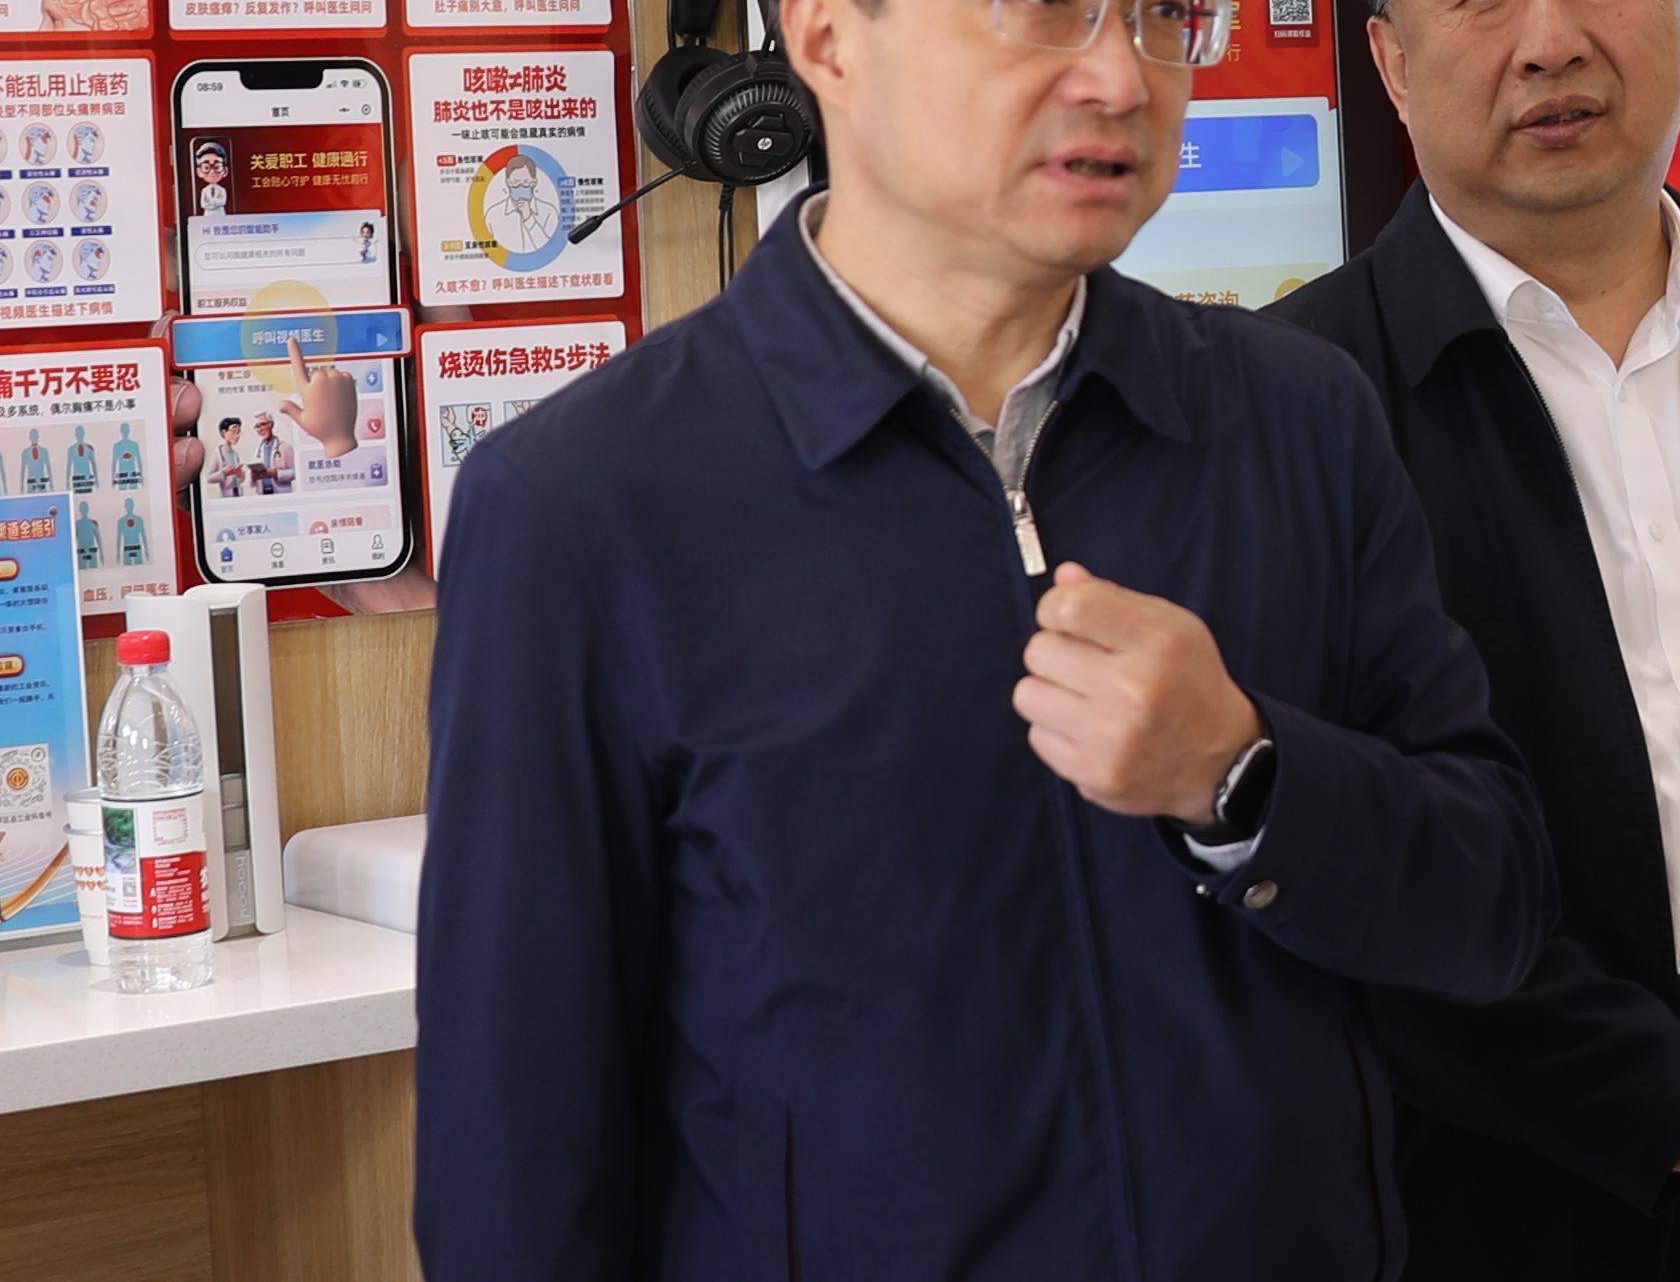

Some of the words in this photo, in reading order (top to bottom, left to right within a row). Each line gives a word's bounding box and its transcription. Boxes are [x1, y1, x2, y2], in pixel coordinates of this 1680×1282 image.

[433, 97, 596, 123] 肺炎也不是咳出来的
[251, 153, 307, 170] 关爱职工
[312, 151, 368, 168] 健康通行
